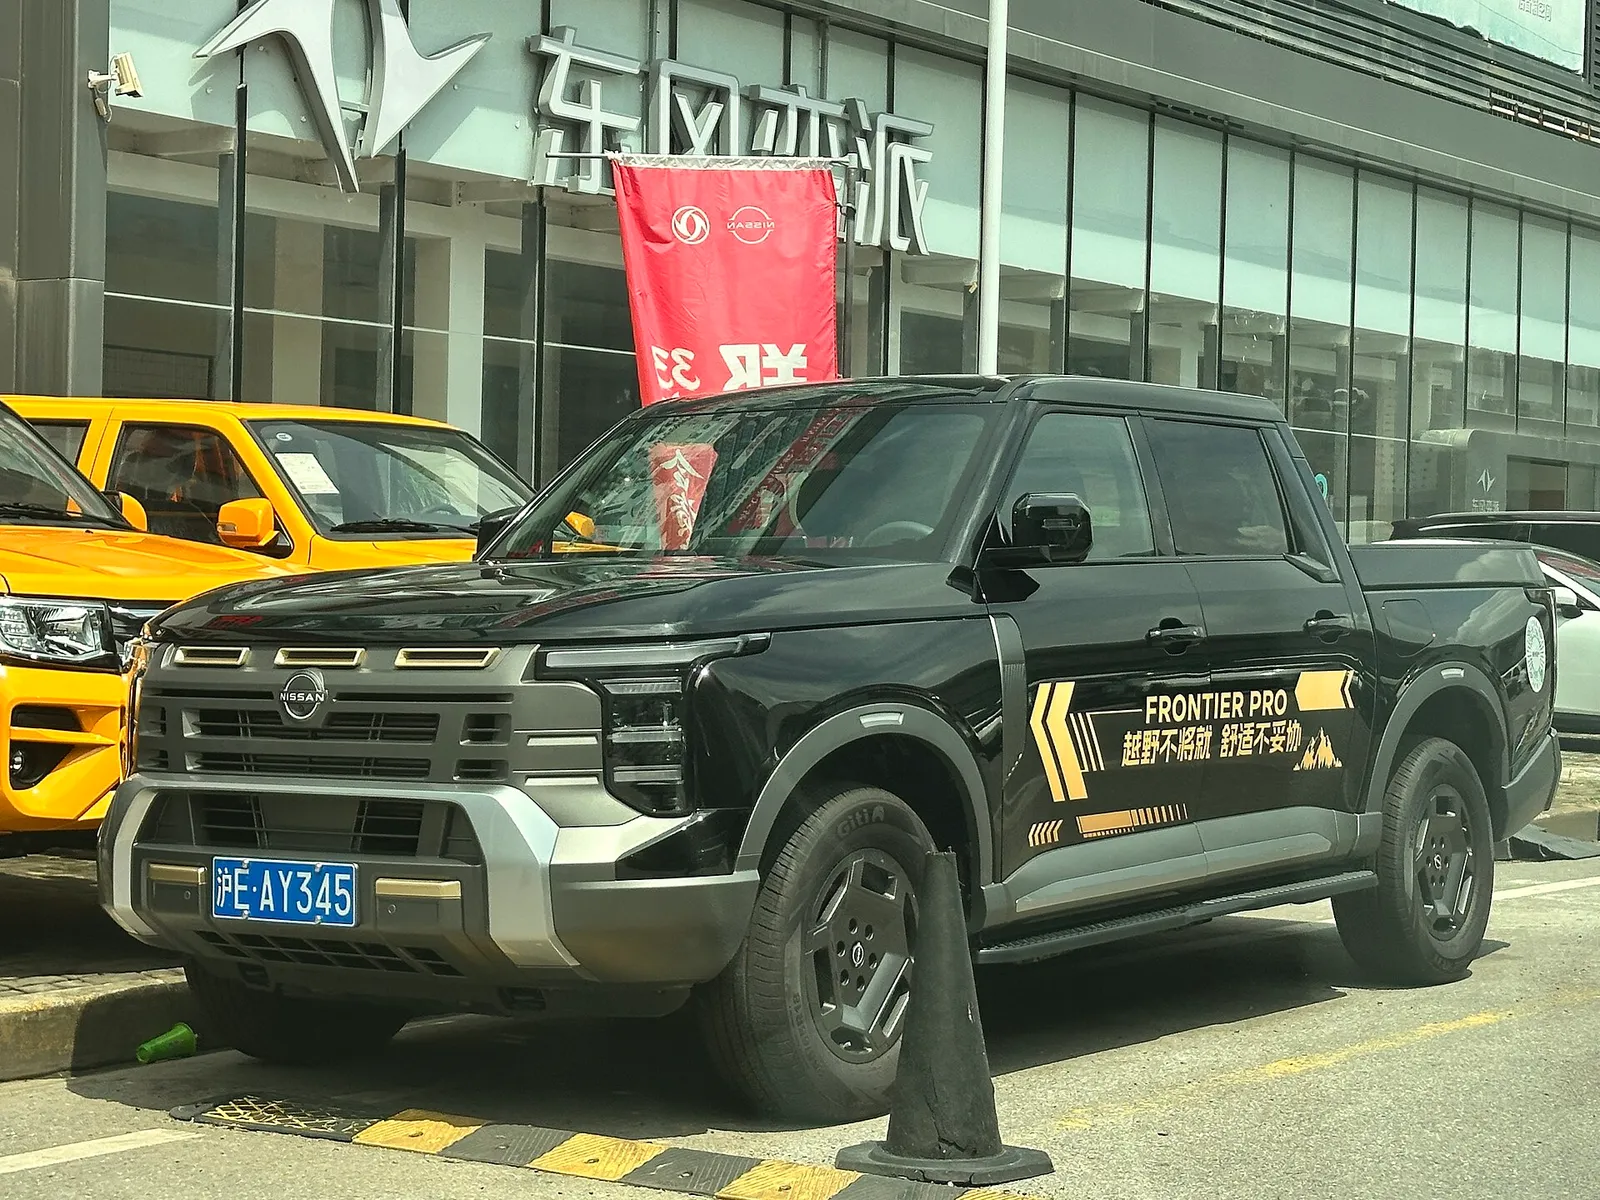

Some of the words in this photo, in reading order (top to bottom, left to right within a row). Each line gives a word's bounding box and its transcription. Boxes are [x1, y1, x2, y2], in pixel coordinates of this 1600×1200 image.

[280, 692, 325, 702] NISSAN
[1145, 692, 1244, 724] FRONTIER
[1249, 688, 1288, 717] PRO
[1219, 719, 1302, 758] 舒适不妥协
[216, 866, 351, 917] 沪E·AY345
